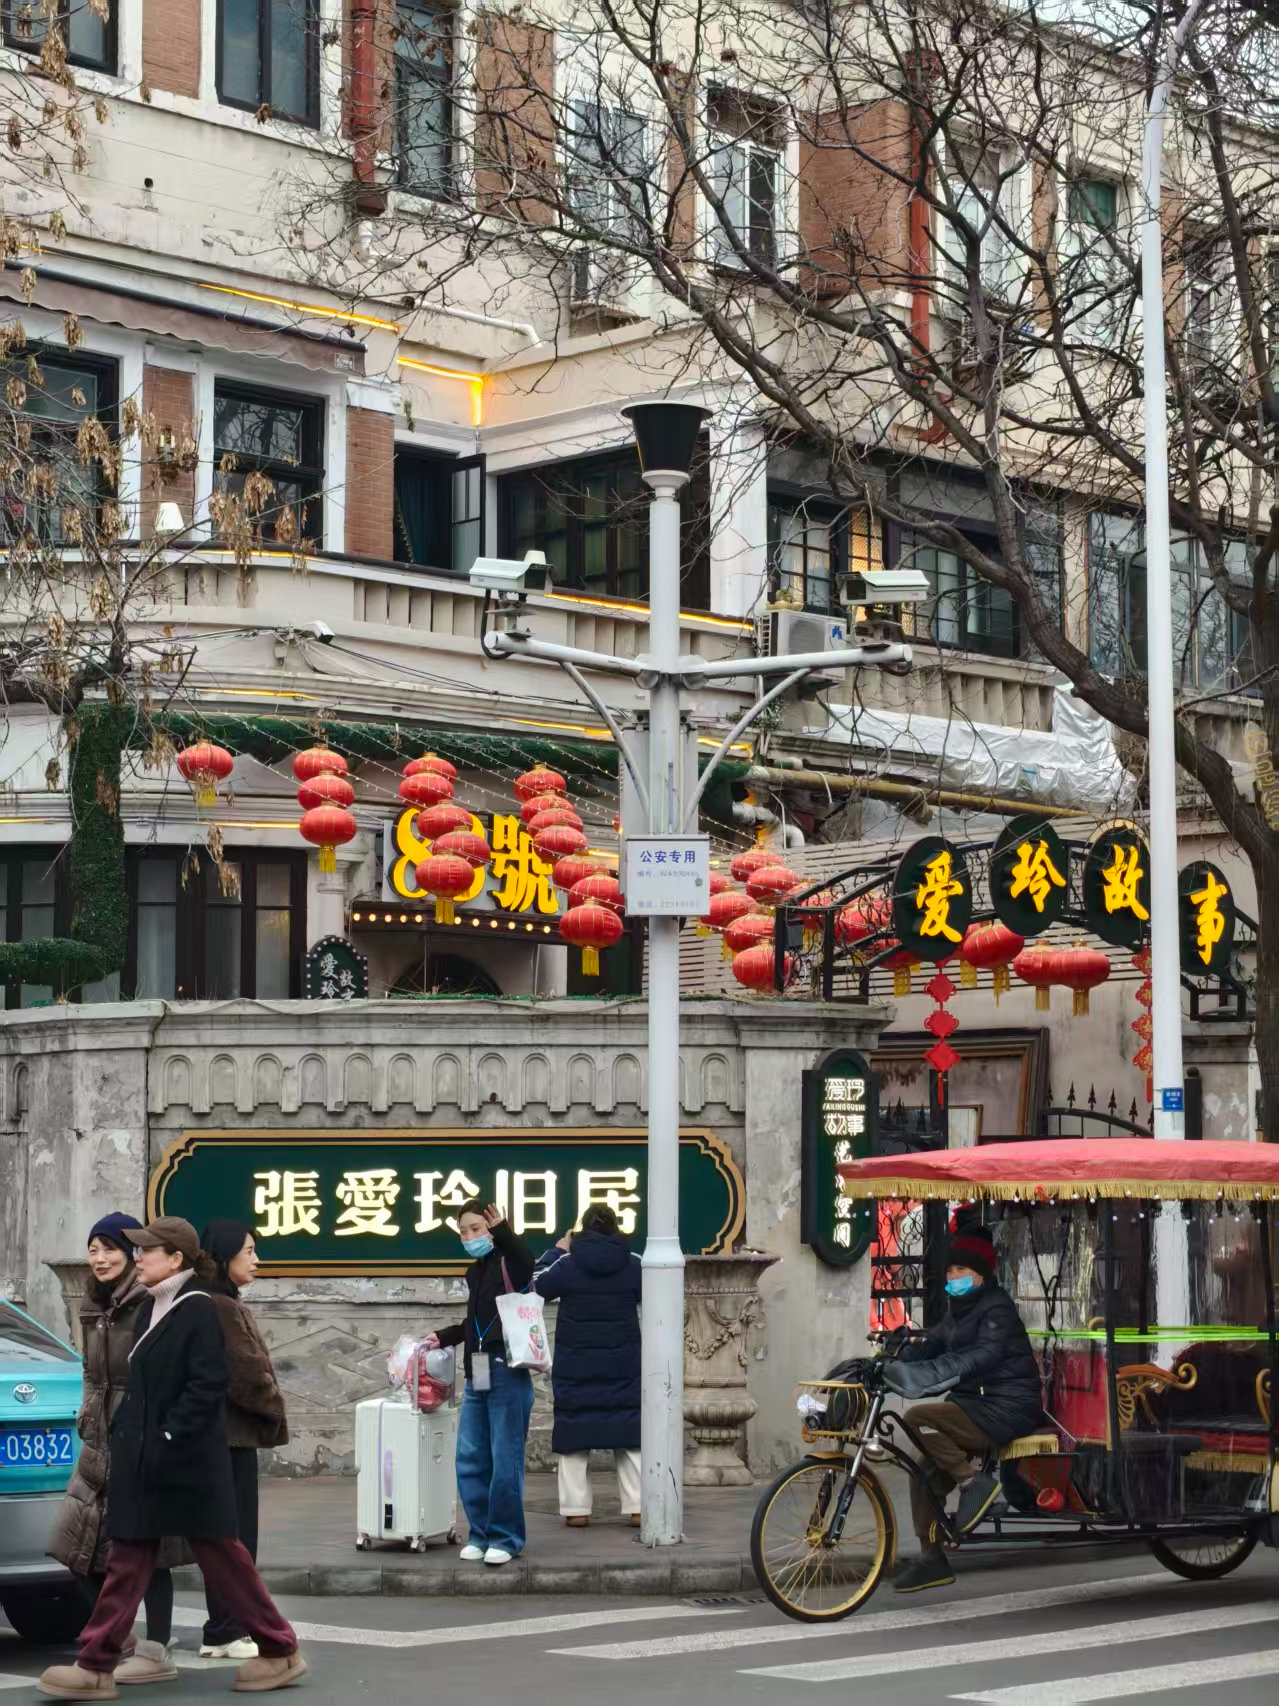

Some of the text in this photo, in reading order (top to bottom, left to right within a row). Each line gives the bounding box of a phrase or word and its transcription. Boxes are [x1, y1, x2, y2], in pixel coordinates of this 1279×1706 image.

[640, 850, 696, 863] 公安专用
[253, 1167, 641, 1237] 張愛玲旧居
